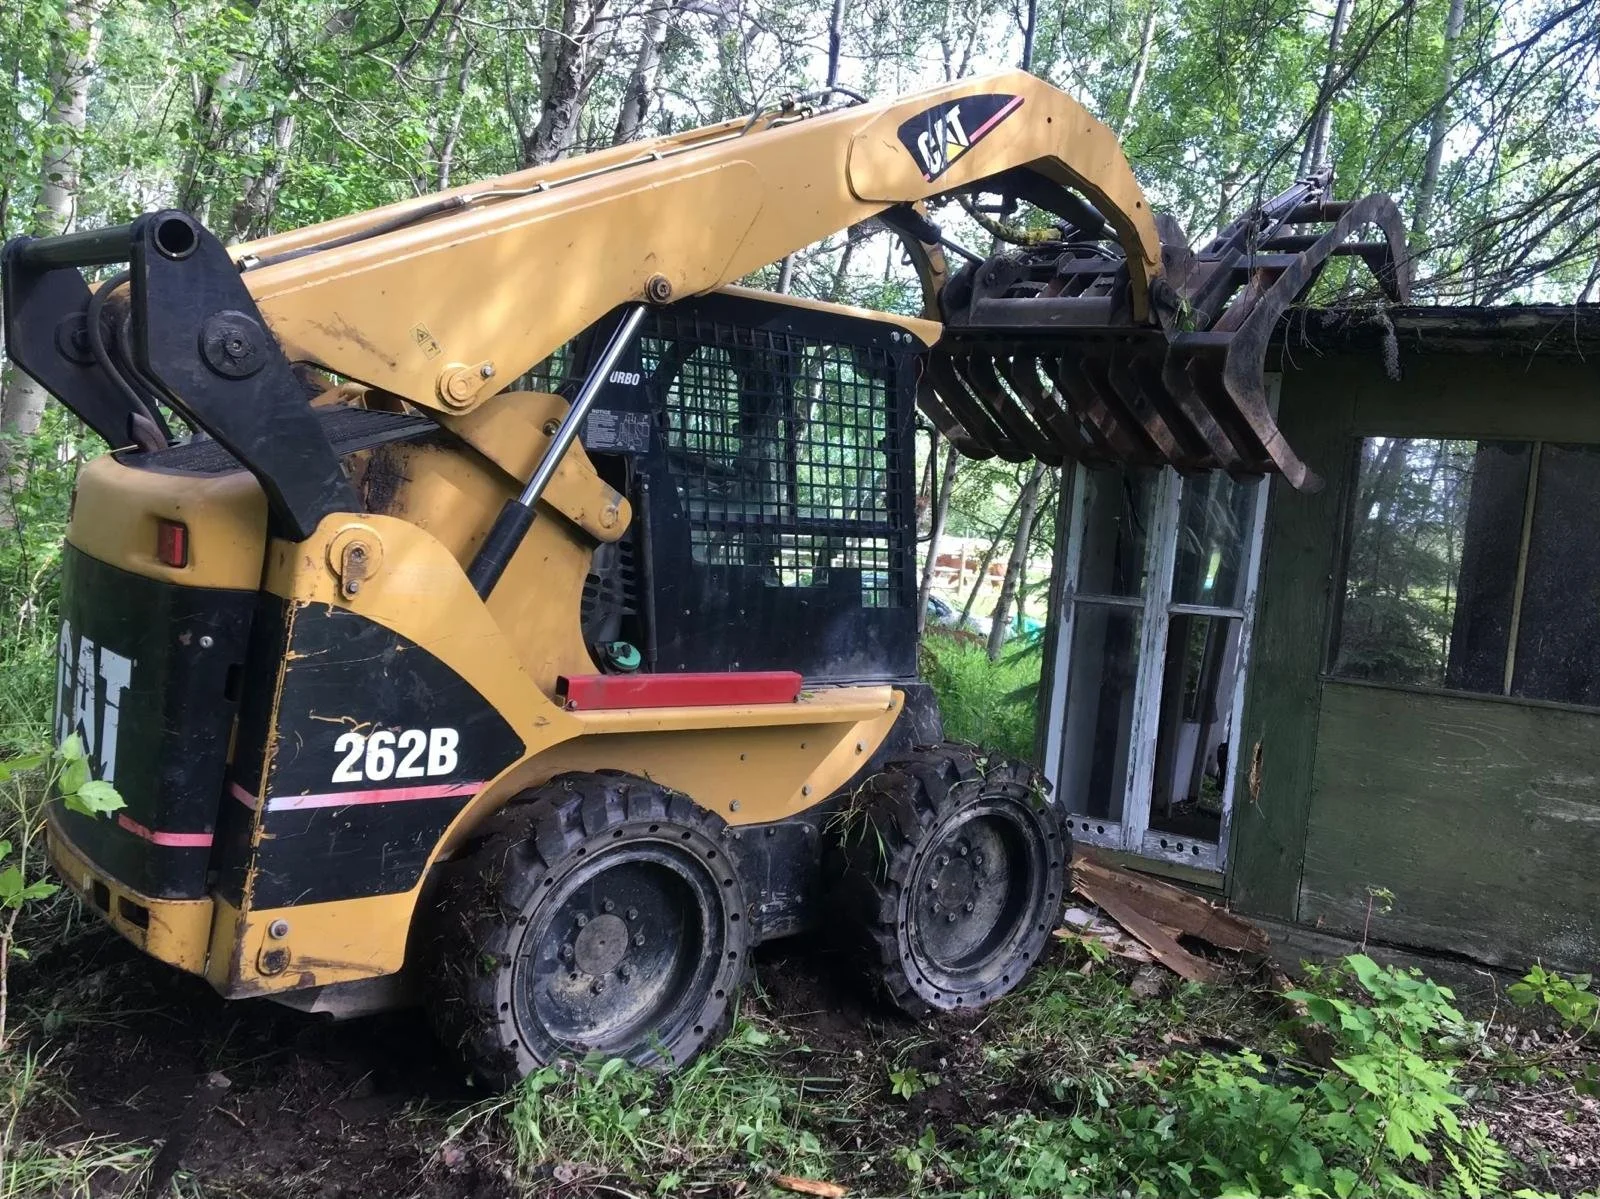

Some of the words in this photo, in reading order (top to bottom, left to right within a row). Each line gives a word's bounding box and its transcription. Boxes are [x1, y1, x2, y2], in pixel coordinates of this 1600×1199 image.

[917, 104, 970, 174] CAT
[609, 371, 640, 386] URBO
[331, 727, 460, 783] 262B
